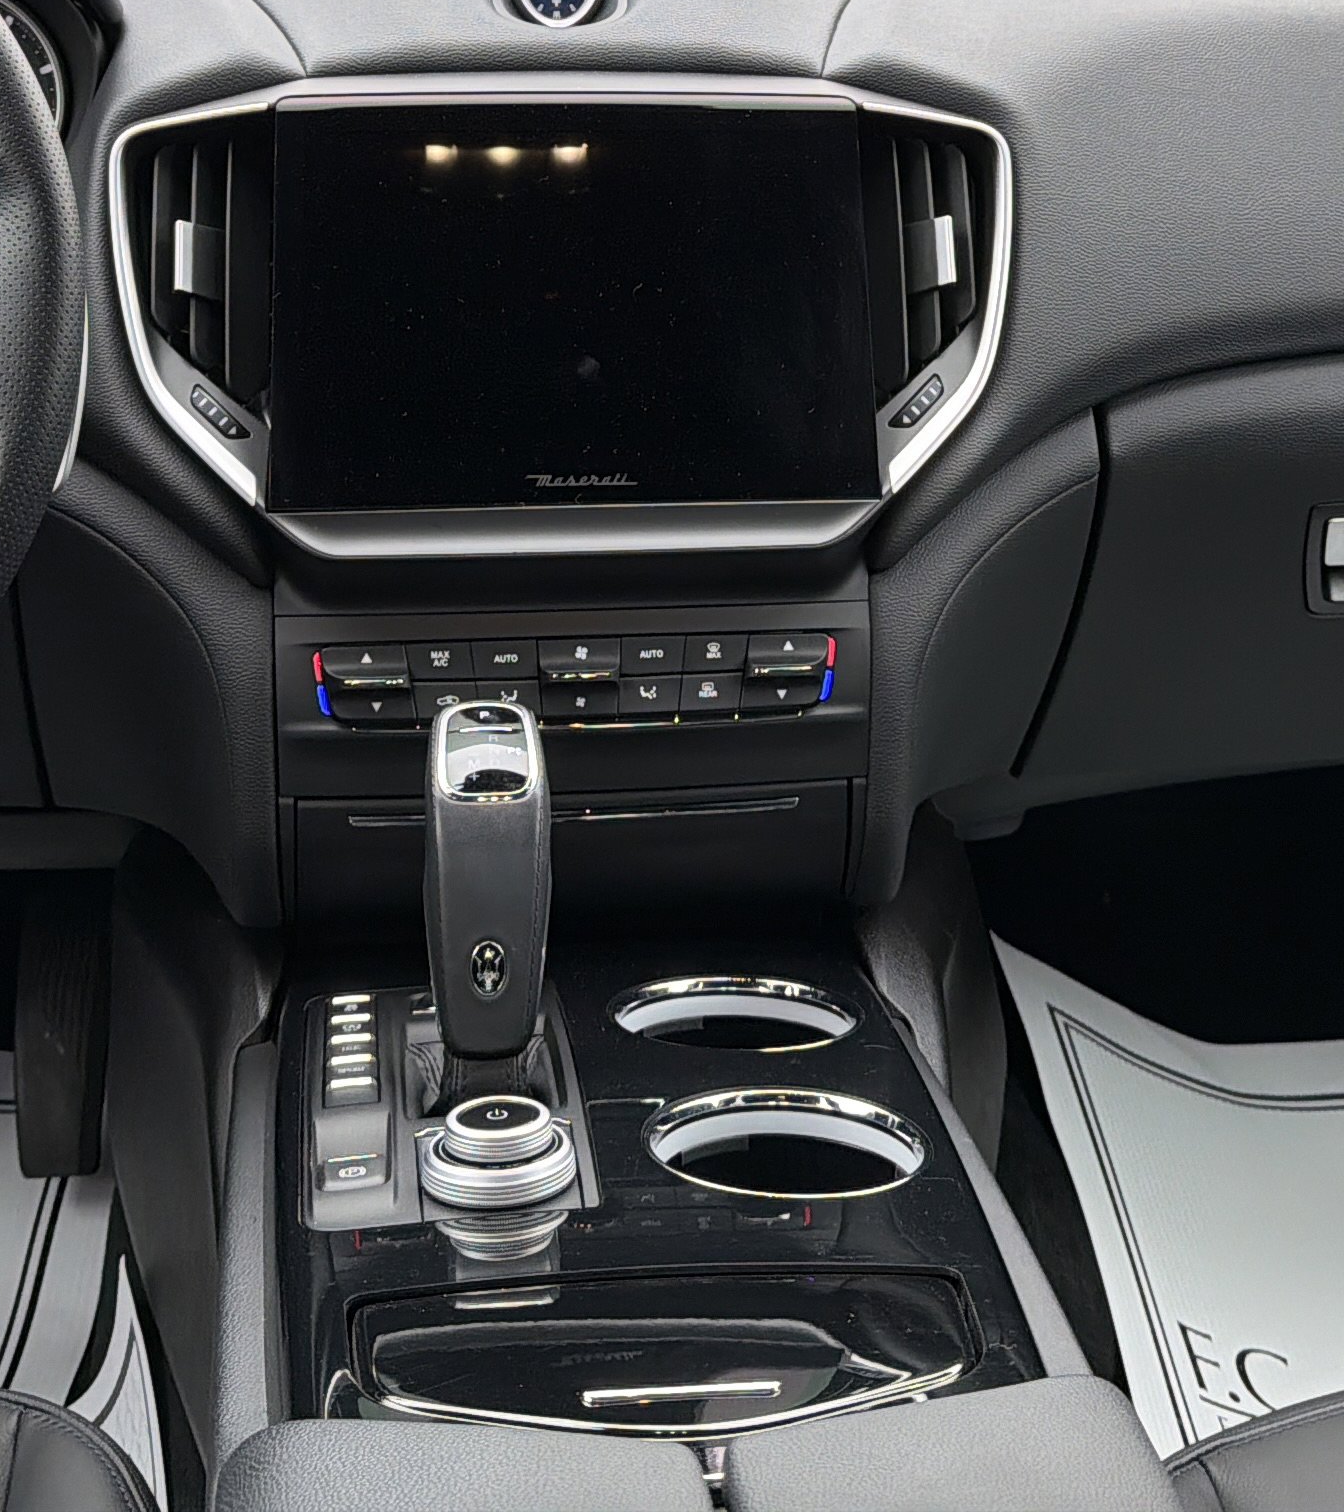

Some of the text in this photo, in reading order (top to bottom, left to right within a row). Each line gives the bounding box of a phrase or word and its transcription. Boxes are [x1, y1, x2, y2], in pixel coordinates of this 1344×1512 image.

[430, 650, 451, 659] MAX
[493, 653, 519, 663] AUTO
[640, 649, 664, 659] AUTO
[706, 651, 722, 659] MAX
[432, 658, 449, 667] A/C
[698, 690, 718, 698] REAR
